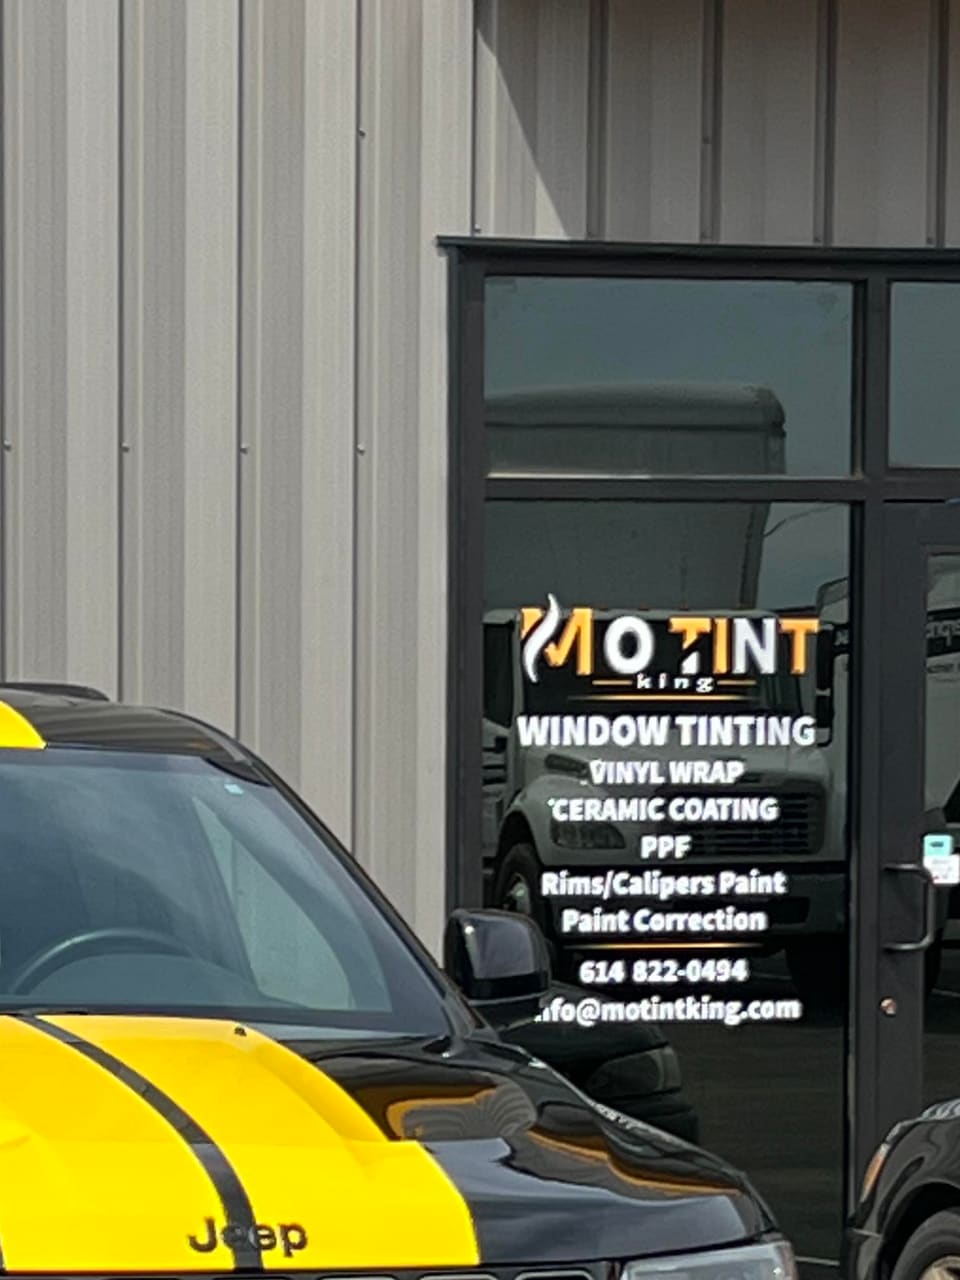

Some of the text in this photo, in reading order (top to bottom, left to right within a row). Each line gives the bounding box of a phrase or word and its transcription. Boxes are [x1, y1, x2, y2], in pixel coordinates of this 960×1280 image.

[668, 616, 820, 676] TINT
[636, 673, 715, 693] king
[517, 715, 816, 747] WINDOW TINTING
[589, 759, 745, 785] VINYL WRAP
[549, 797, 779, 822] CERAMIC COATING
[641, 835, 692, 859] PPF
[541, 868, 787, 900] Rims/Calipers Paint
[562, 905, 768, 933] Paint Correction
[579, 958, 749, 984] 614 822-0494
[534, 995, 803, 1027] nfo@motintking.com
[188, 1216, 308, 1257] Jeep
